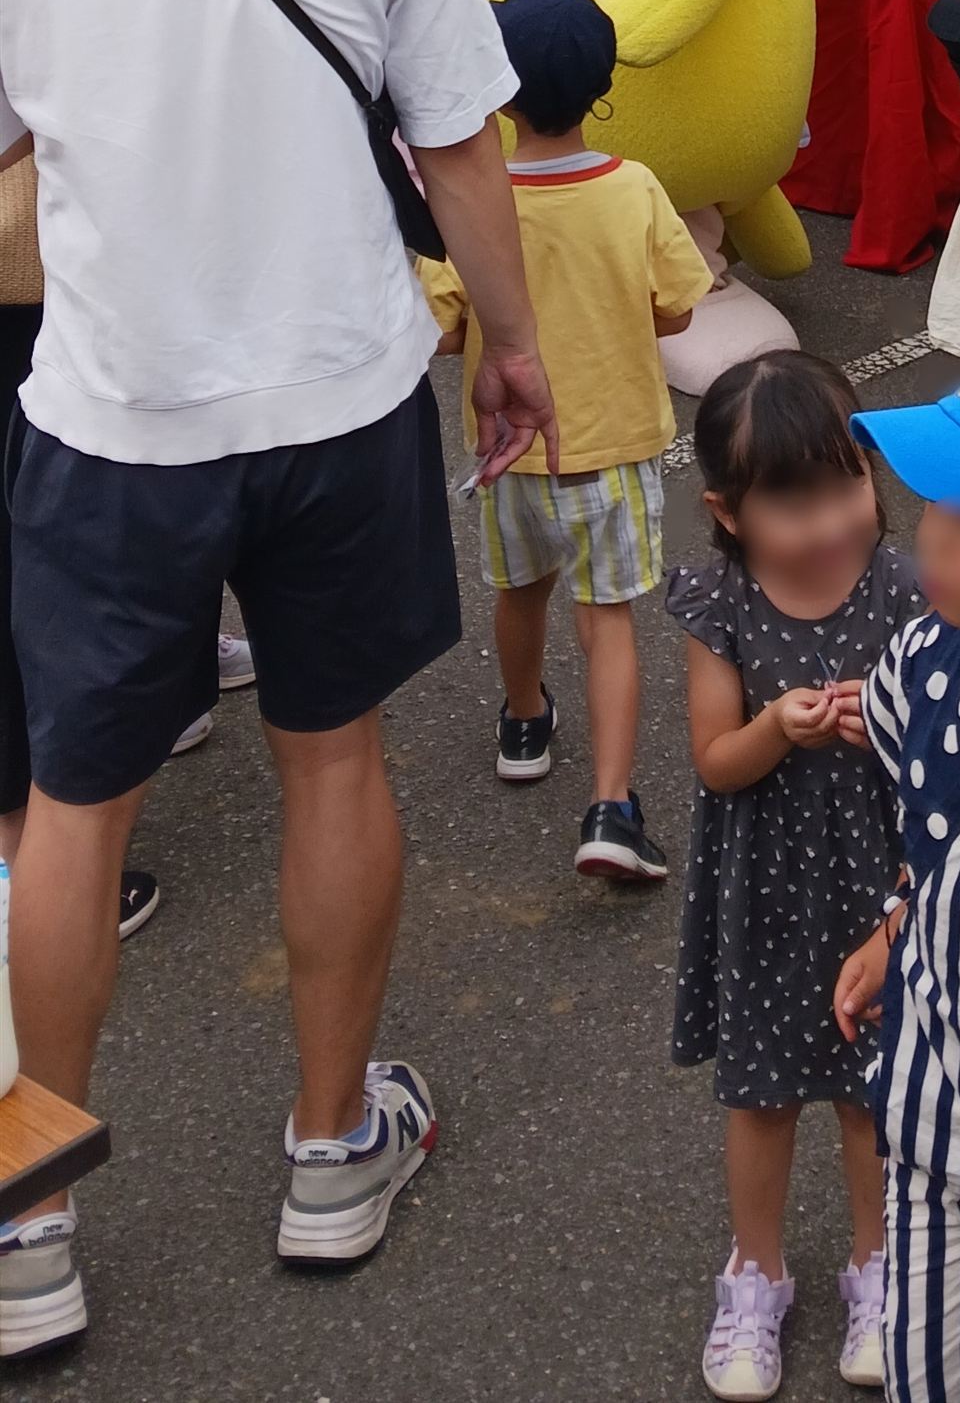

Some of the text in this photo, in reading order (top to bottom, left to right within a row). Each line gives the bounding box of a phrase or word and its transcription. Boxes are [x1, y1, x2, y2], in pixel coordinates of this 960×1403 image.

[308, 1149, 329, 1158] new
[300, 1158, 340, 1167] balance
[42, 1223, 64, 1234] new
